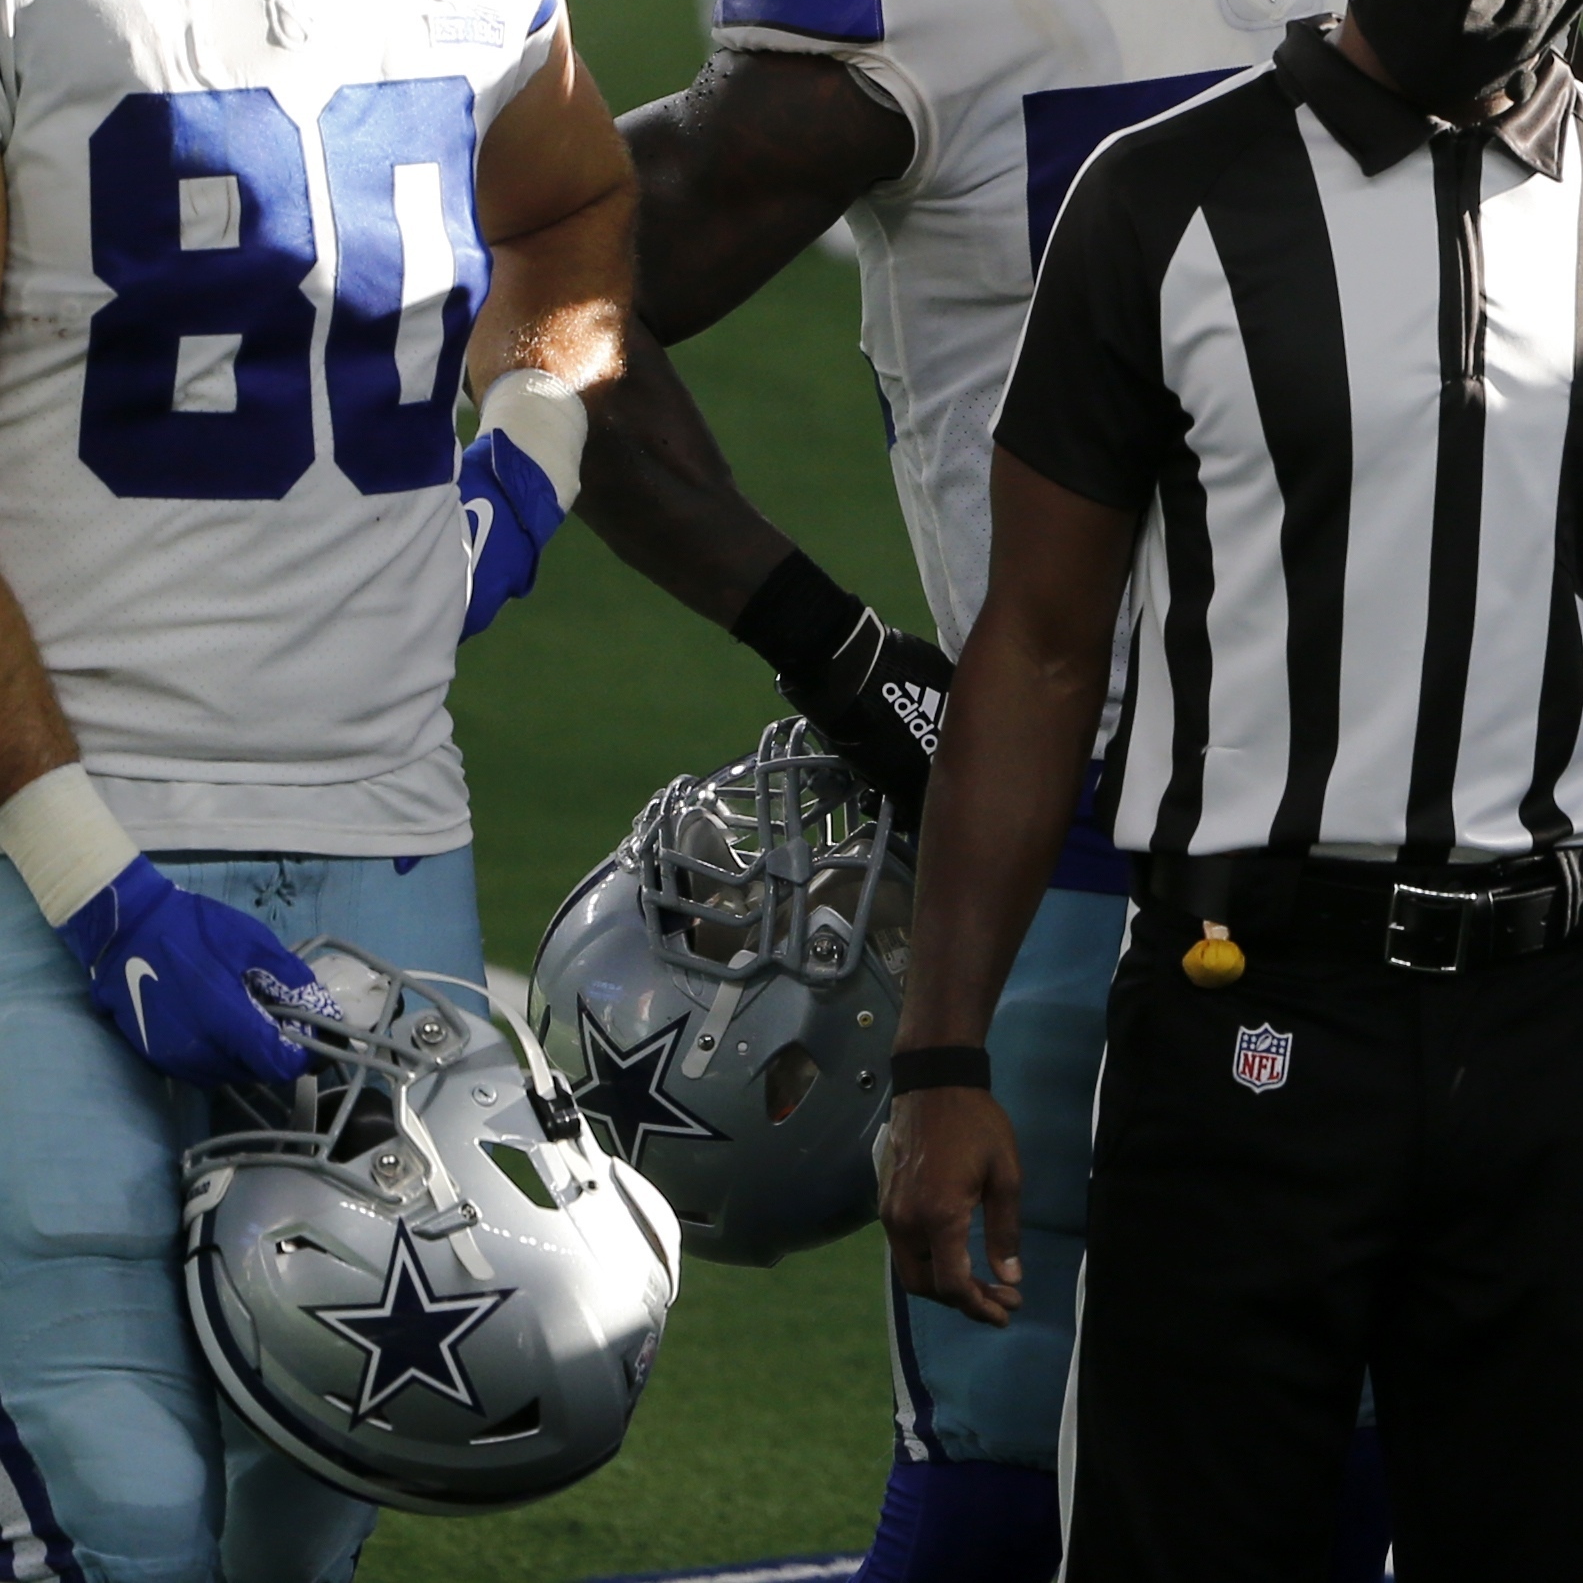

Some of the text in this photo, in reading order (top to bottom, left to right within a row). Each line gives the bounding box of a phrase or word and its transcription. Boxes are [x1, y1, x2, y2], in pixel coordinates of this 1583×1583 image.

[79, 75, 493, 499] 80
[881, 682, 939, 756] adida
[1239, 1050, 1280, 1082] NFL
